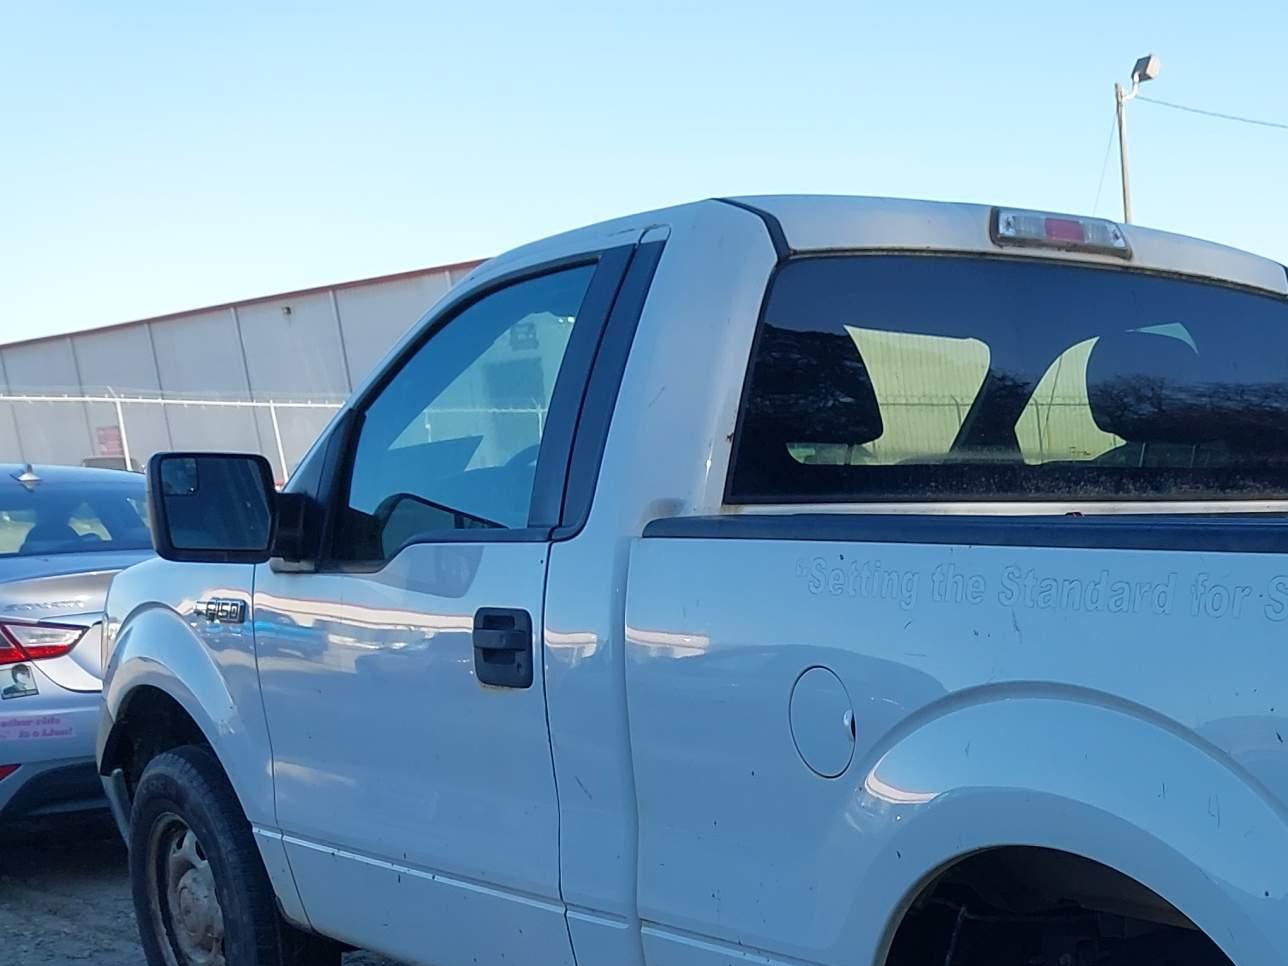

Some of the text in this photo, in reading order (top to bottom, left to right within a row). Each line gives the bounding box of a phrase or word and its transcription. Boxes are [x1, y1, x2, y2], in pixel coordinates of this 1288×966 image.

[931, 562, 985, 604] the
[998, 564, 1178, 616] Standard
[1191, 572, 1251, 619] for
